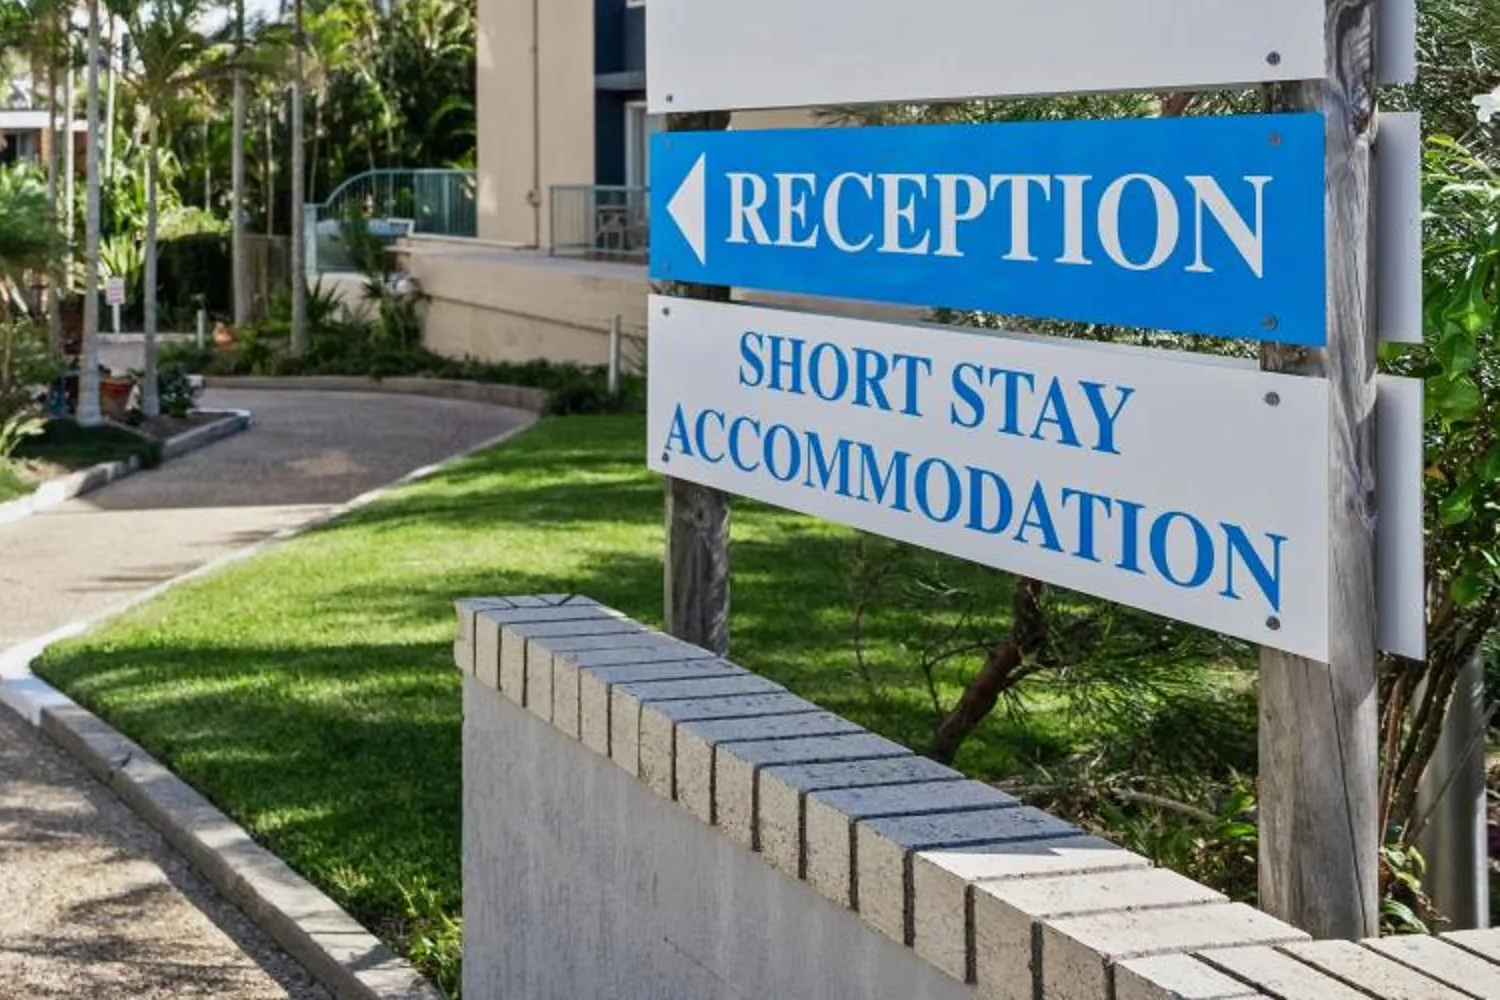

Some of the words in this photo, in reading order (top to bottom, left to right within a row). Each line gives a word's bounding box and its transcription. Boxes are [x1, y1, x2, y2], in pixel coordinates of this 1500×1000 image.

[725, 172, 1273, 278] RECEPTION
[739, 331, 932, 416] SHORT
[950, 363, 1135, 454] STAY
[665, 403, 1287, 612] ACCOMMODATION
